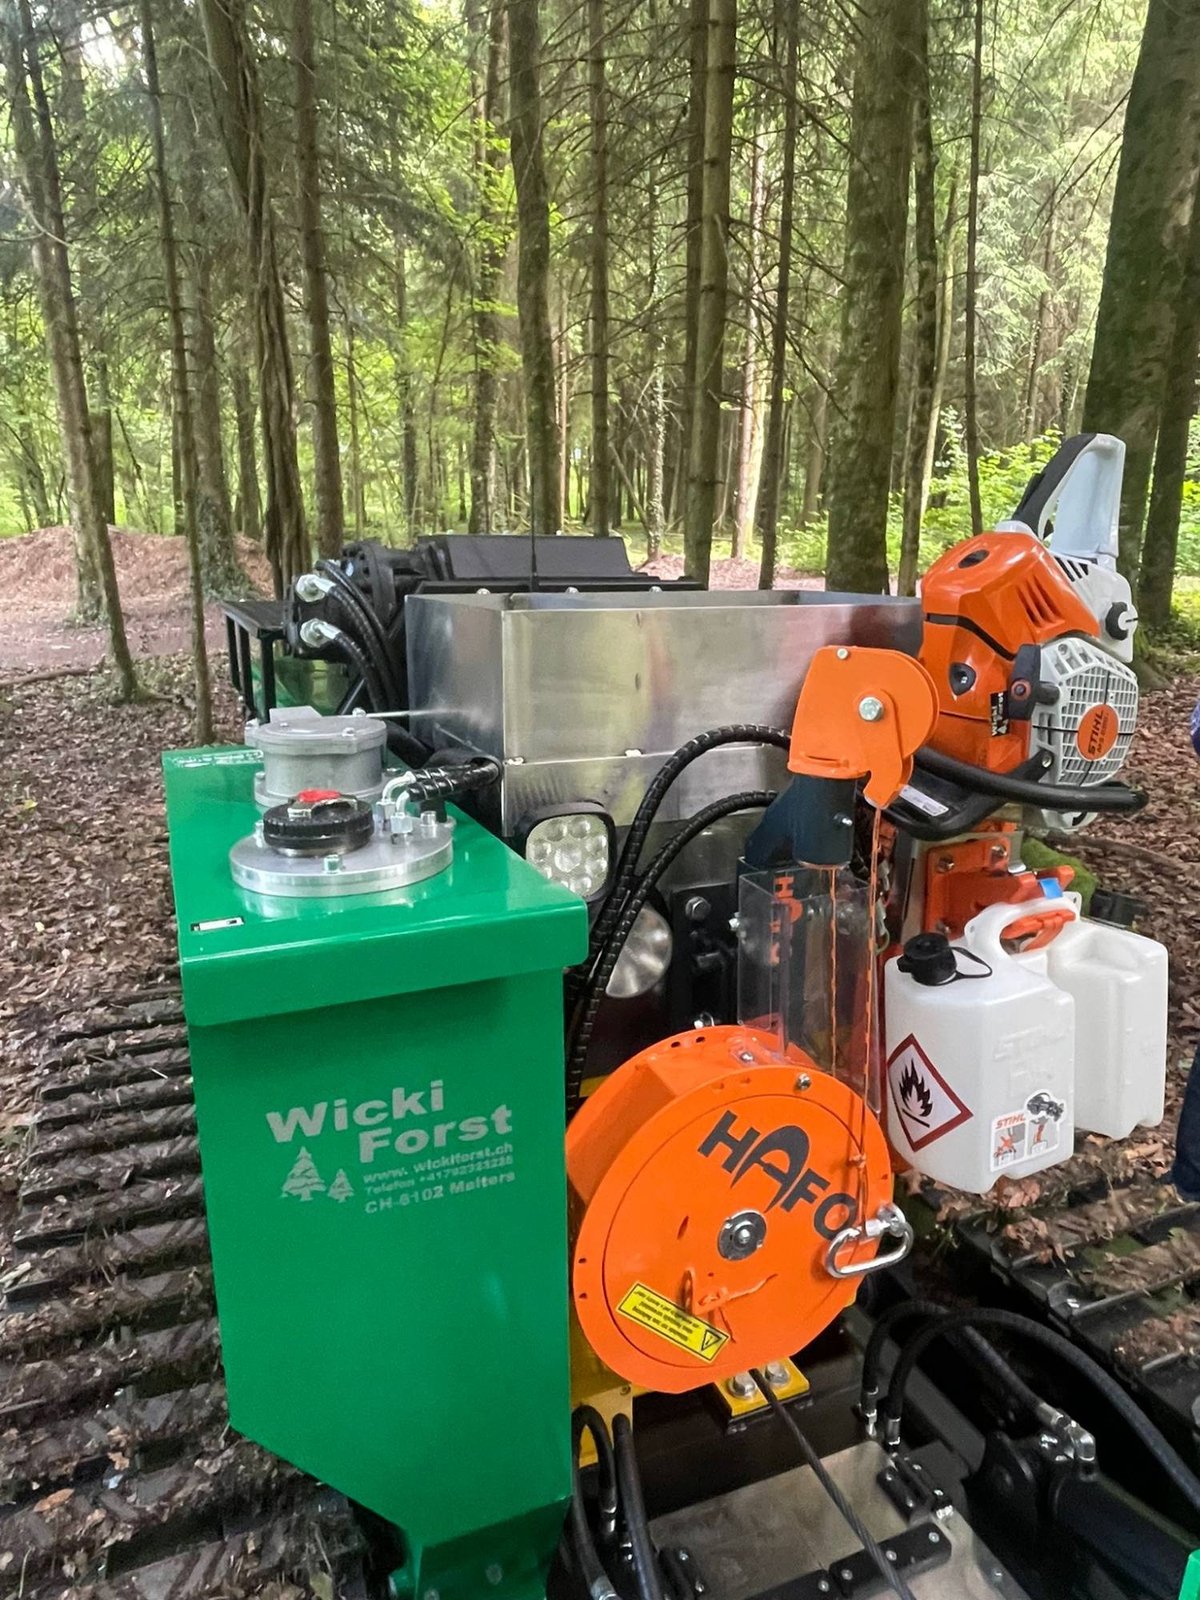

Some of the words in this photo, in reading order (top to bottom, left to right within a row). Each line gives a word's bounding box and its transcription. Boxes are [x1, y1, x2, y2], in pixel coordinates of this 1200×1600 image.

[1087, 709, 1104, 755] STIHL
[265, 1079, 444, 1143] Wicki
[359, 1104, 513, 1163] Forst
[996, 1113, 1025, 1129] STIHL
[413, 1142, 513, 1173] wickiforst.ch
[697, 1110, 858, 1241] HAFO
